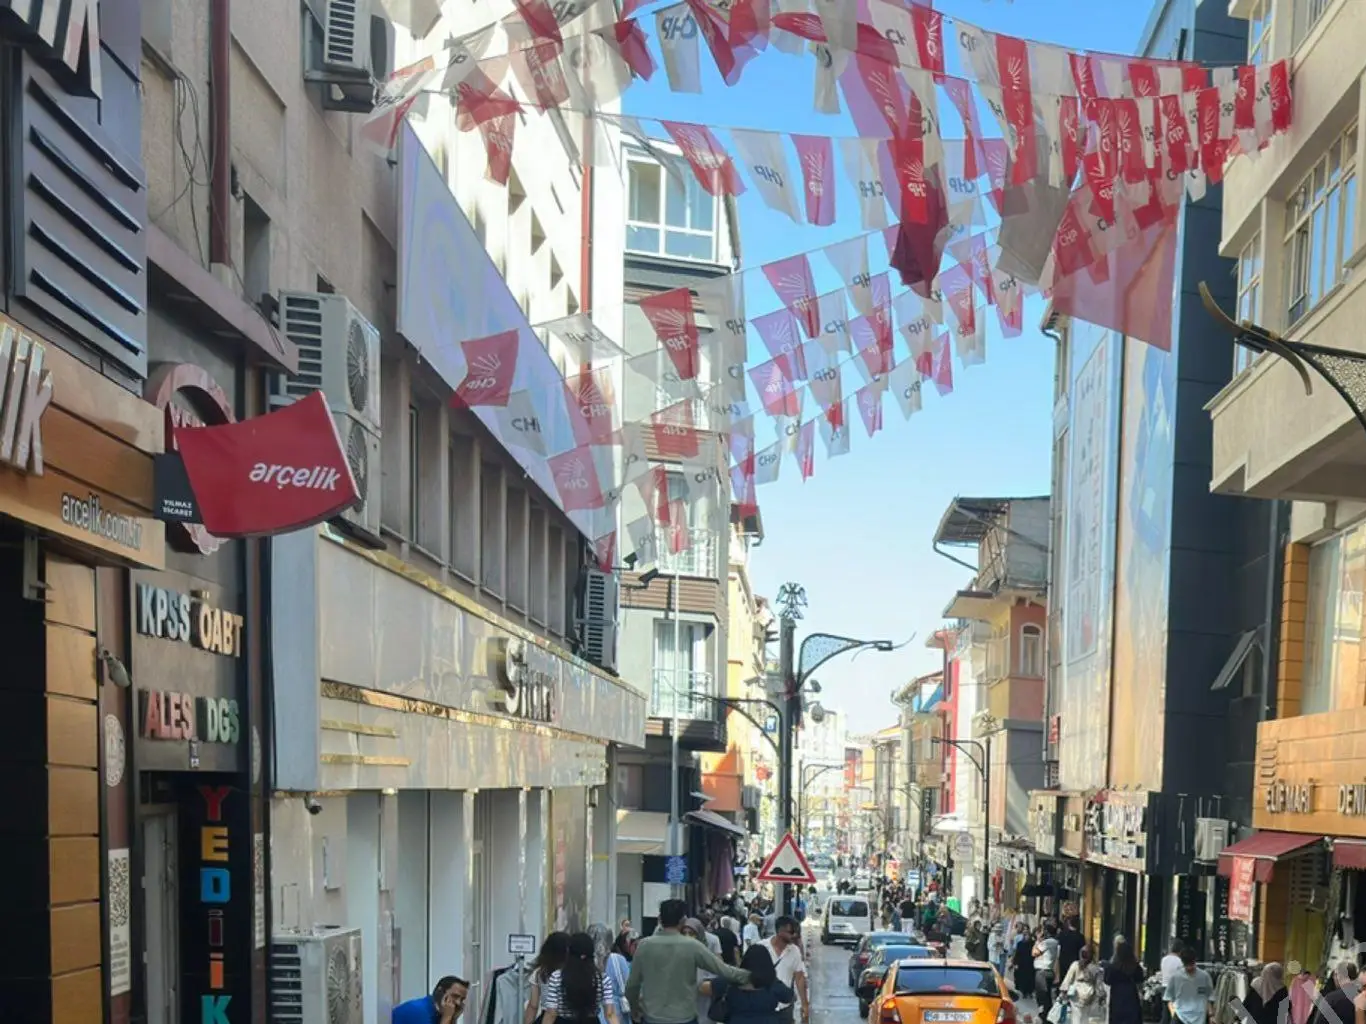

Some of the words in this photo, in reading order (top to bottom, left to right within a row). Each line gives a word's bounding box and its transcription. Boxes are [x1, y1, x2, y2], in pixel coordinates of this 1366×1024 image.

[249, 462, 342, 492] arçelik
[138, 582, 191, 643] KPSS
[199, 590, 244, 658] ÖABT
[143, 689, 194, 741] ALES
[205, 697, 241, 745] DGS
